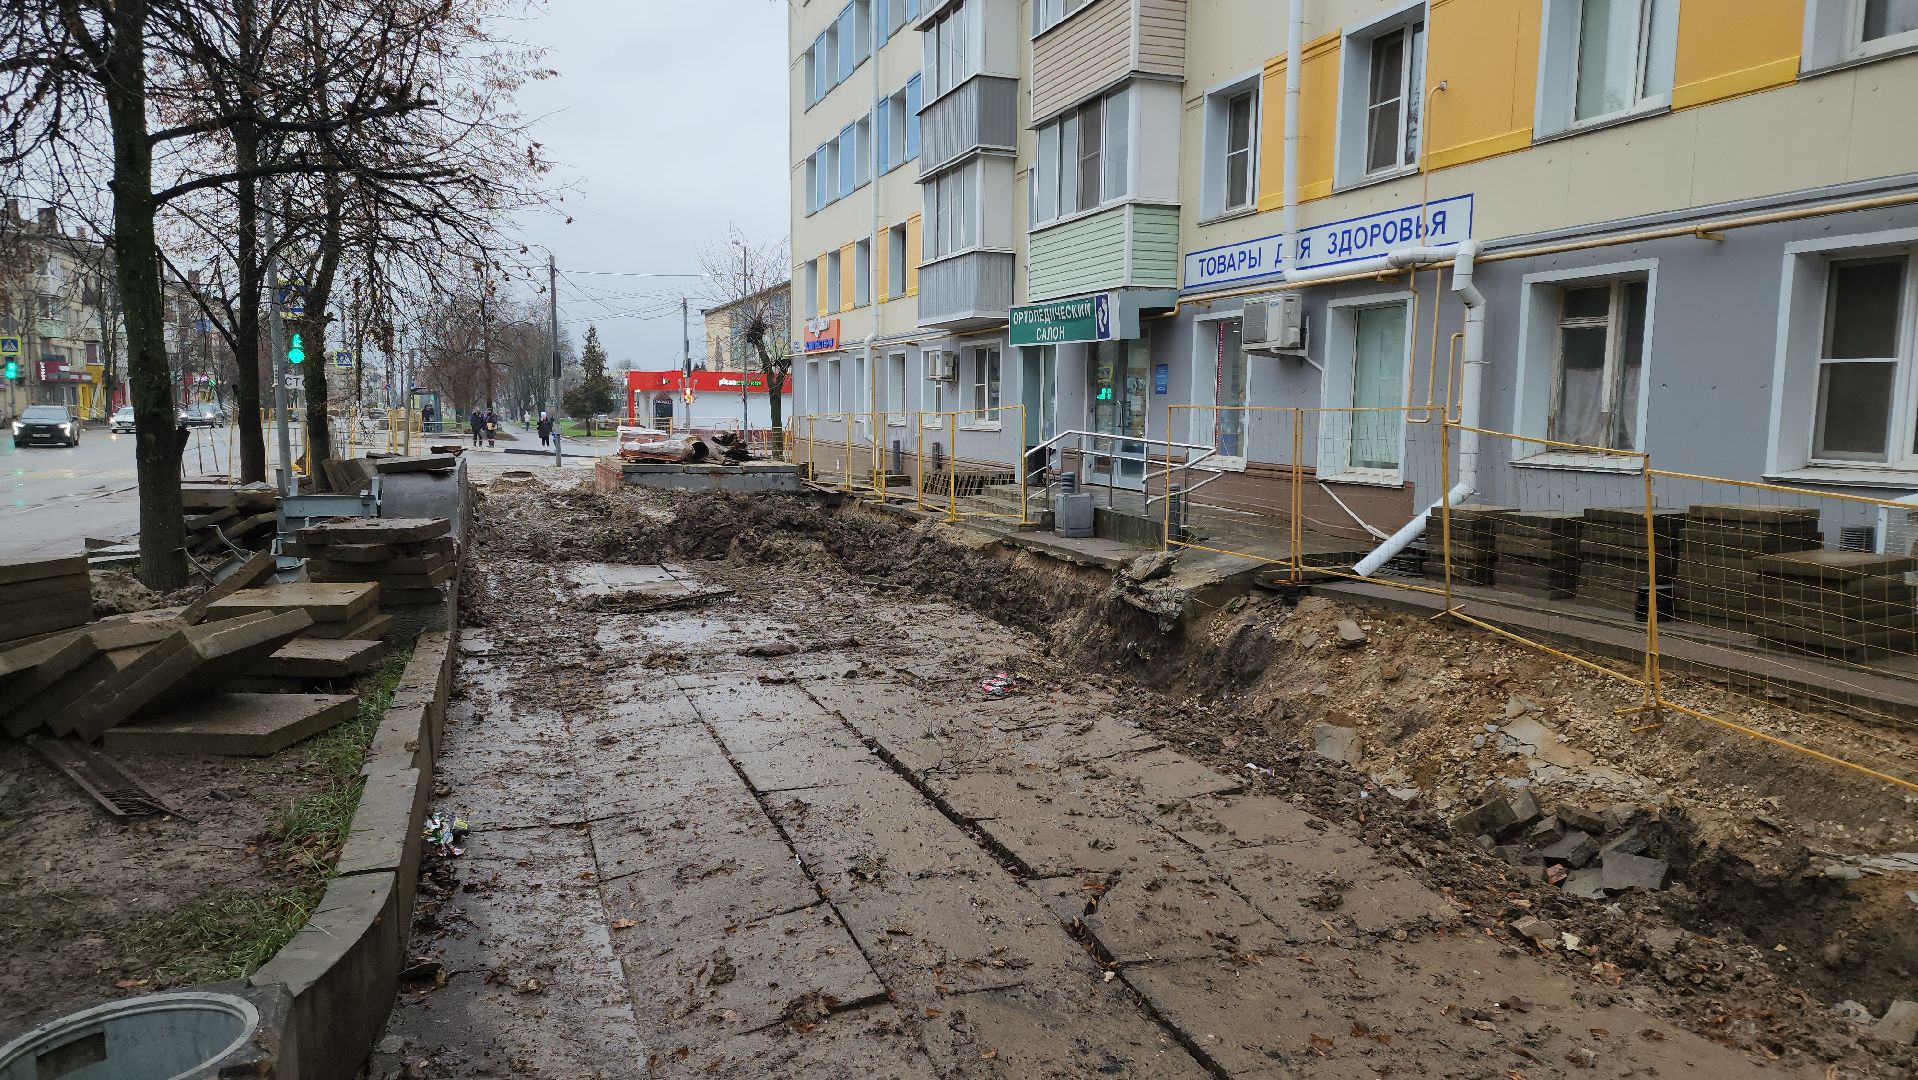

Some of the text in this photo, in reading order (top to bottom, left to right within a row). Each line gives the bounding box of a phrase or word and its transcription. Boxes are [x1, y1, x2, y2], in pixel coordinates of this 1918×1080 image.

[1198, 246, 1262, 277] ТОВАРЫ
[1327, 210, 1447, 256] ЗДОРОВЬЯ
[1013, 300, 1091, 325] ОРТОПЕДИЧЕСКИЙ
[1036, 326, 1065, 341] САЛОН
